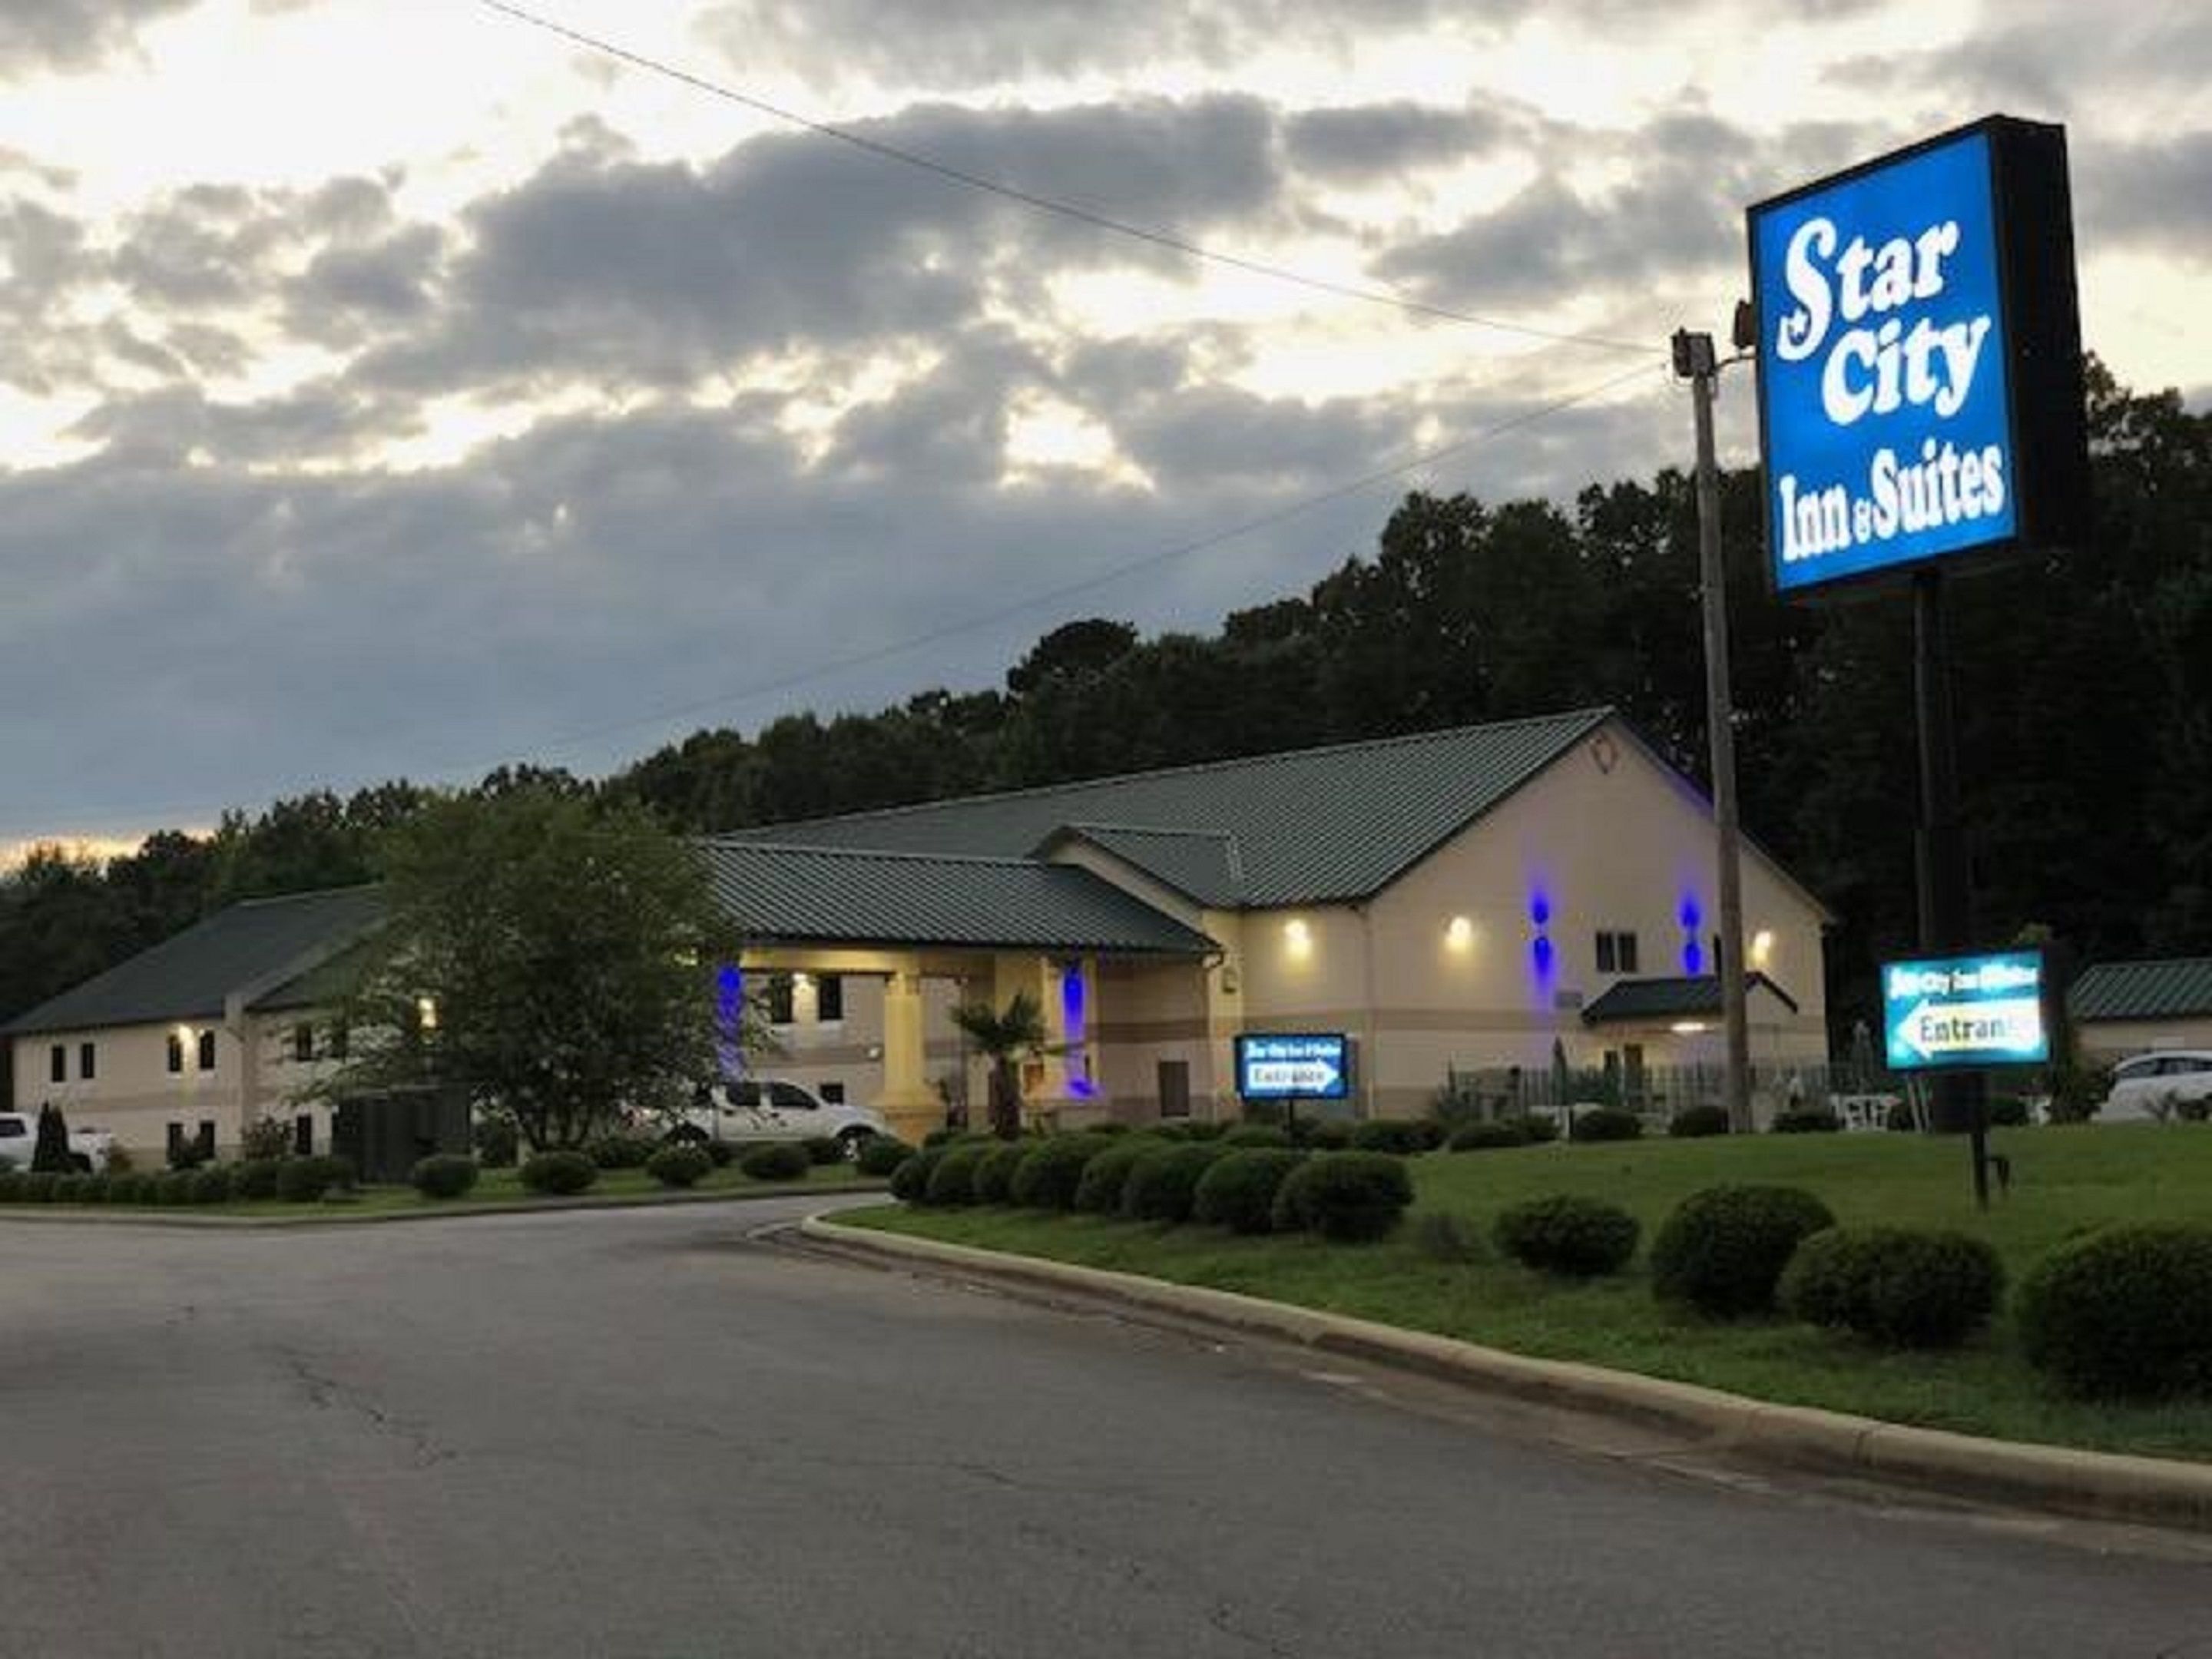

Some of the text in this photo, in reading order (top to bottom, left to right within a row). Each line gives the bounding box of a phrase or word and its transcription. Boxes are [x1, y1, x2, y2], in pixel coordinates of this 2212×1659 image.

[1777, 217, 1959, 360] Star
[1825, 315, 1990, 425] City
[1780, 475, 1849, 561] Inn
[1872, 439, 2005, 539] Suites
[1920, 1014, 2025, 1042] Entran
